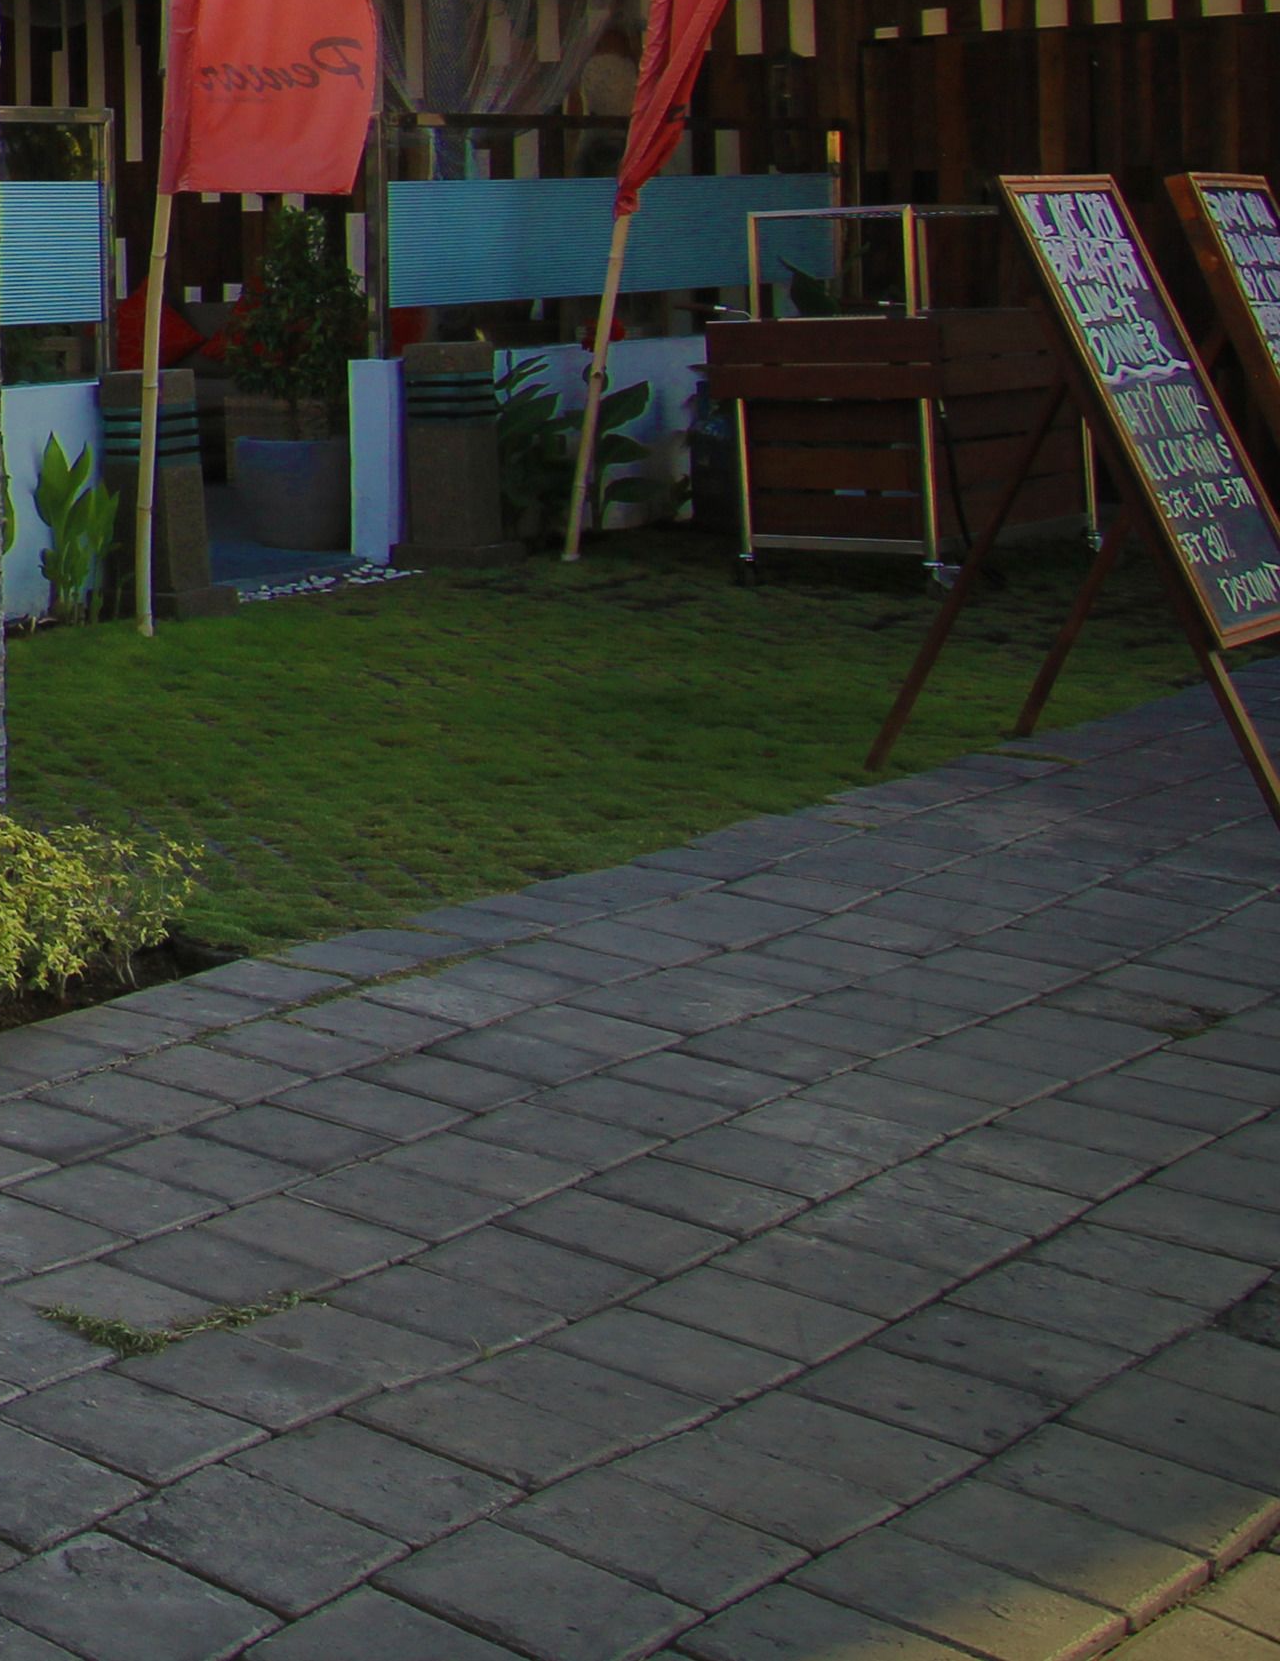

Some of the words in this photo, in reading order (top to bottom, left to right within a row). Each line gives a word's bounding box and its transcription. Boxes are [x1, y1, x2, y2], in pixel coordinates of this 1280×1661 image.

[1039, 238, 1149, 290] BREAKFAST
[1061, 282, 1141, 326] LUNCH
[1085, 322, 1171, 372] DINNER
